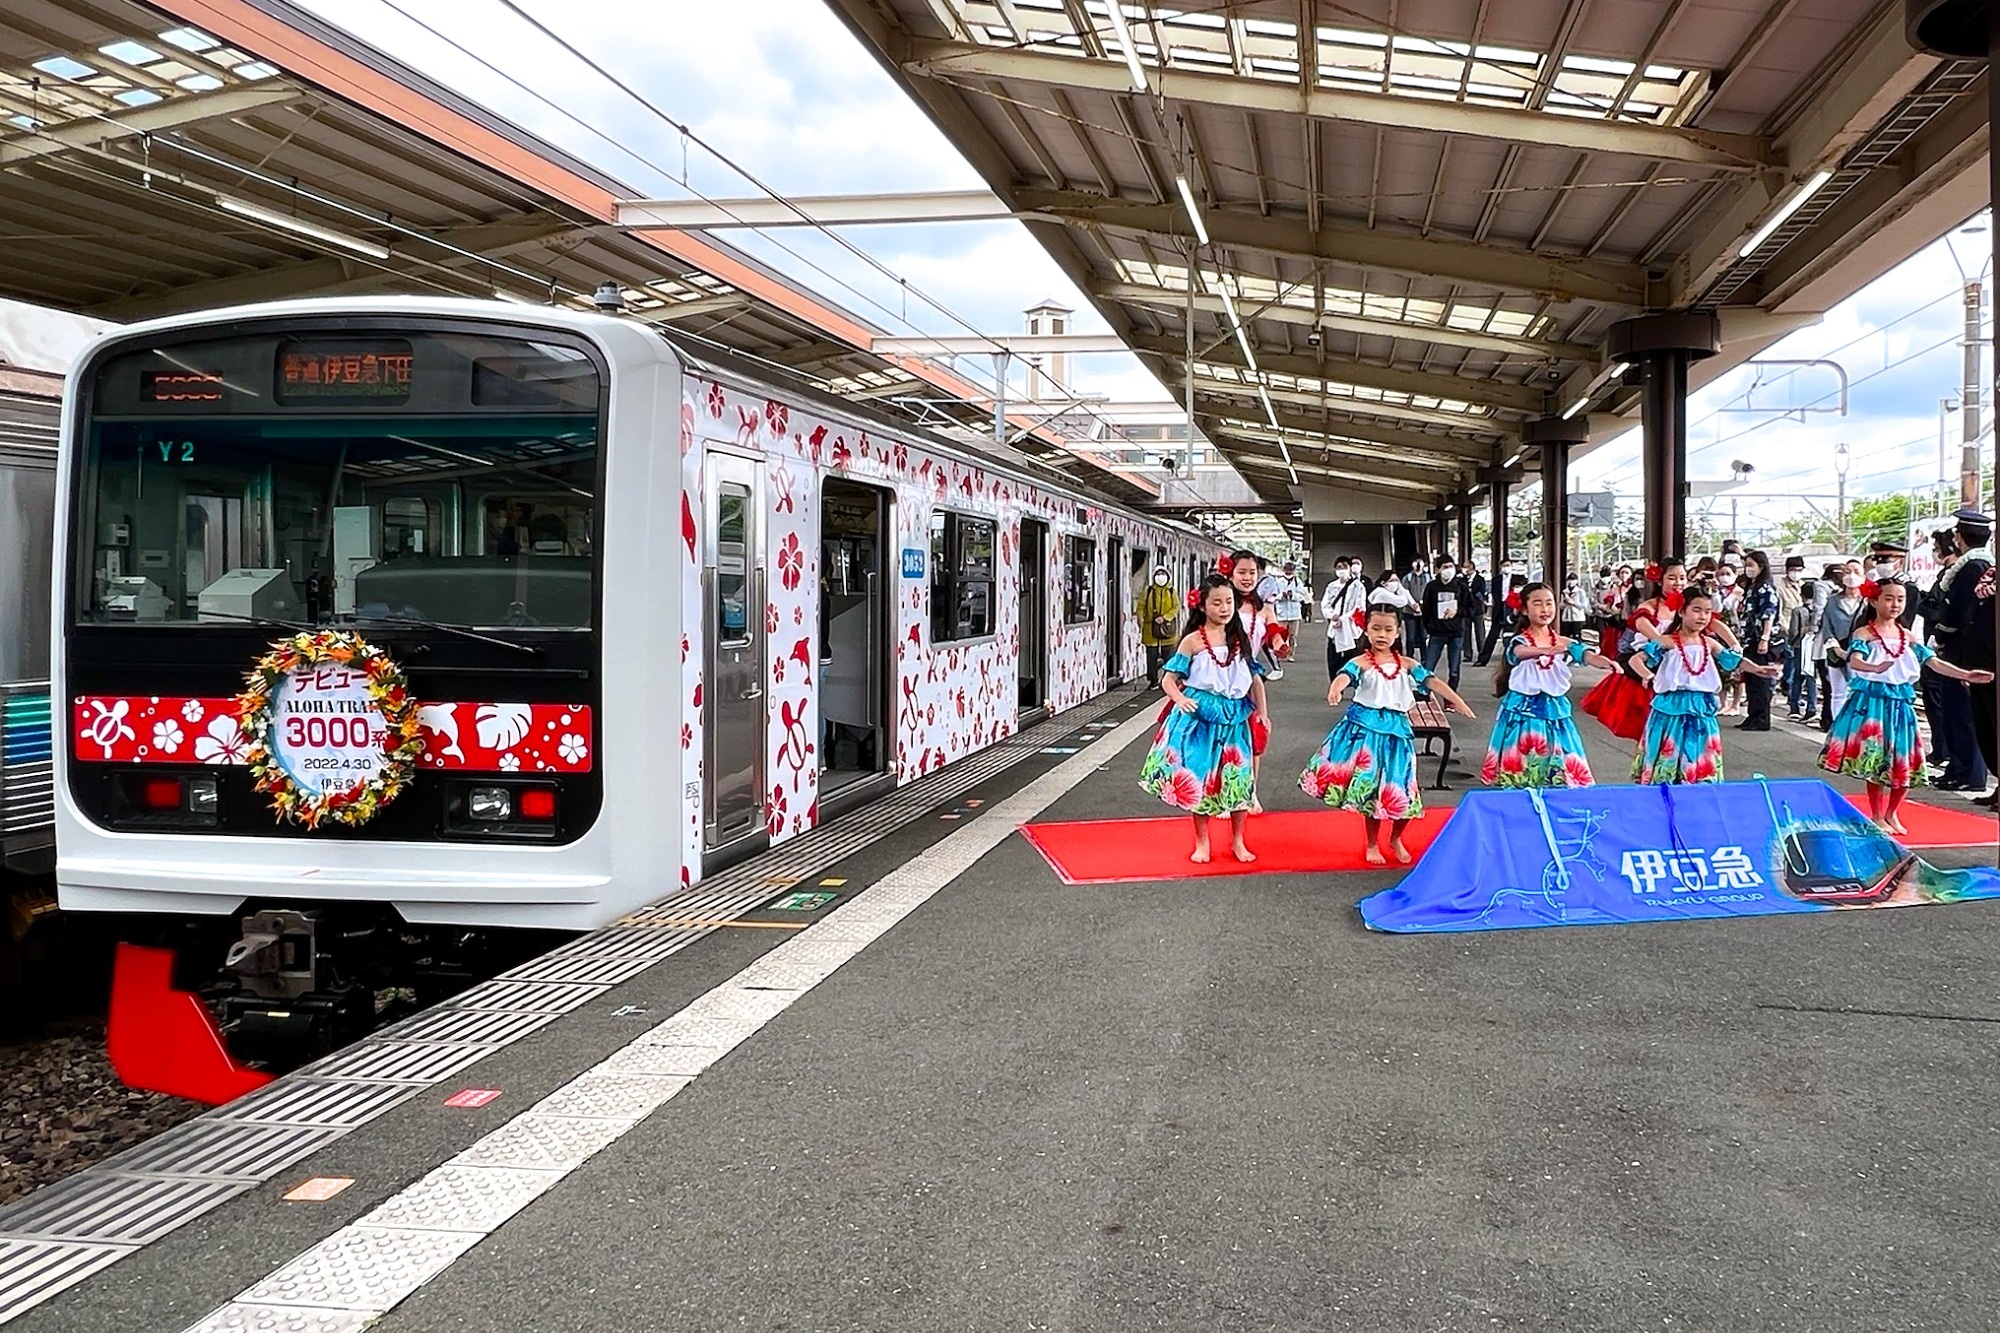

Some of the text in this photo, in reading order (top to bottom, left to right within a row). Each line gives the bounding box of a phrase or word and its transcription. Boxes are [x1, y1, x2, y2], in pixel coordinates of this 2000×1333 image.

[284, 700, 334, 714] ALOHA
[304, 758, 371, 770] 2022.4.30
[320, 777, 356, 791] 伊豆急
[1620, 846, 1765, 894] 伊豆急
